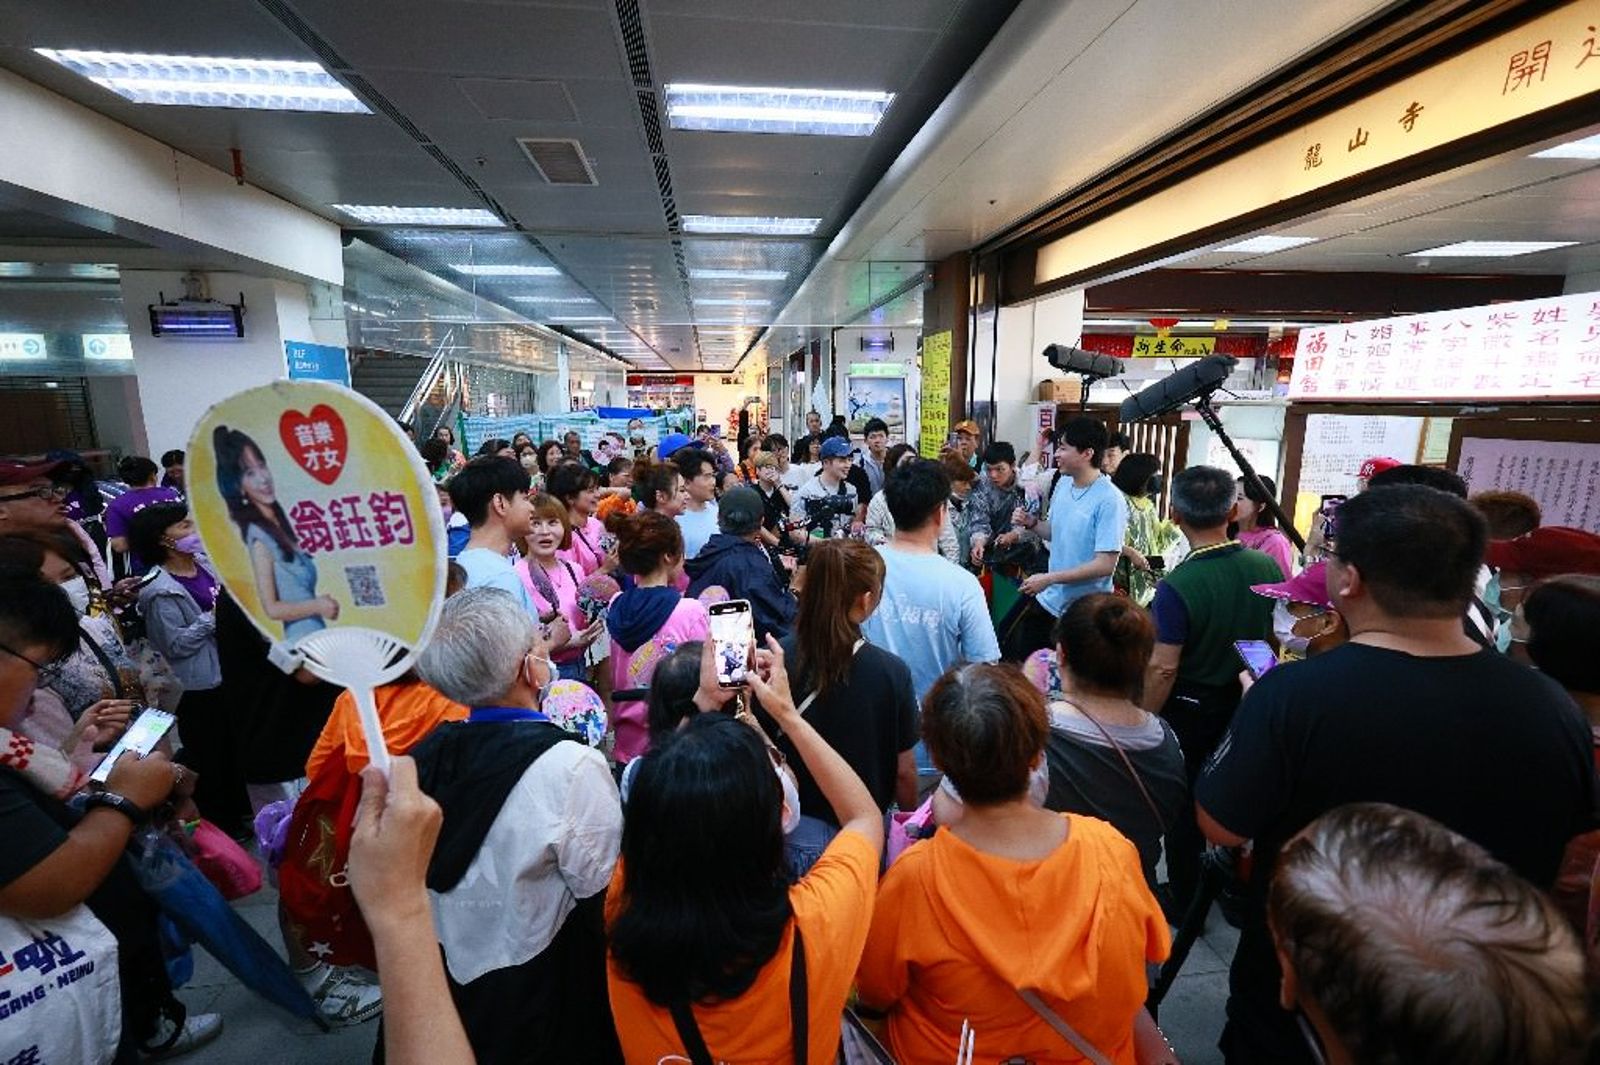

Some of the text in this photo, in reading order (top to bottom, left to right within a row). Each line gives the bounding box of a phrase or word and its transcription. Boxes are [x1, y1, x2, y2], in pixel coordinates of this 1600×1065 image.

[1303, 100, 1425, 171] 龍山寺
[293, 419, 335, 447] 音樂
[303, 447, 342, 471] 才女
[288, 490, 415, 554] 翁鈺鈞
